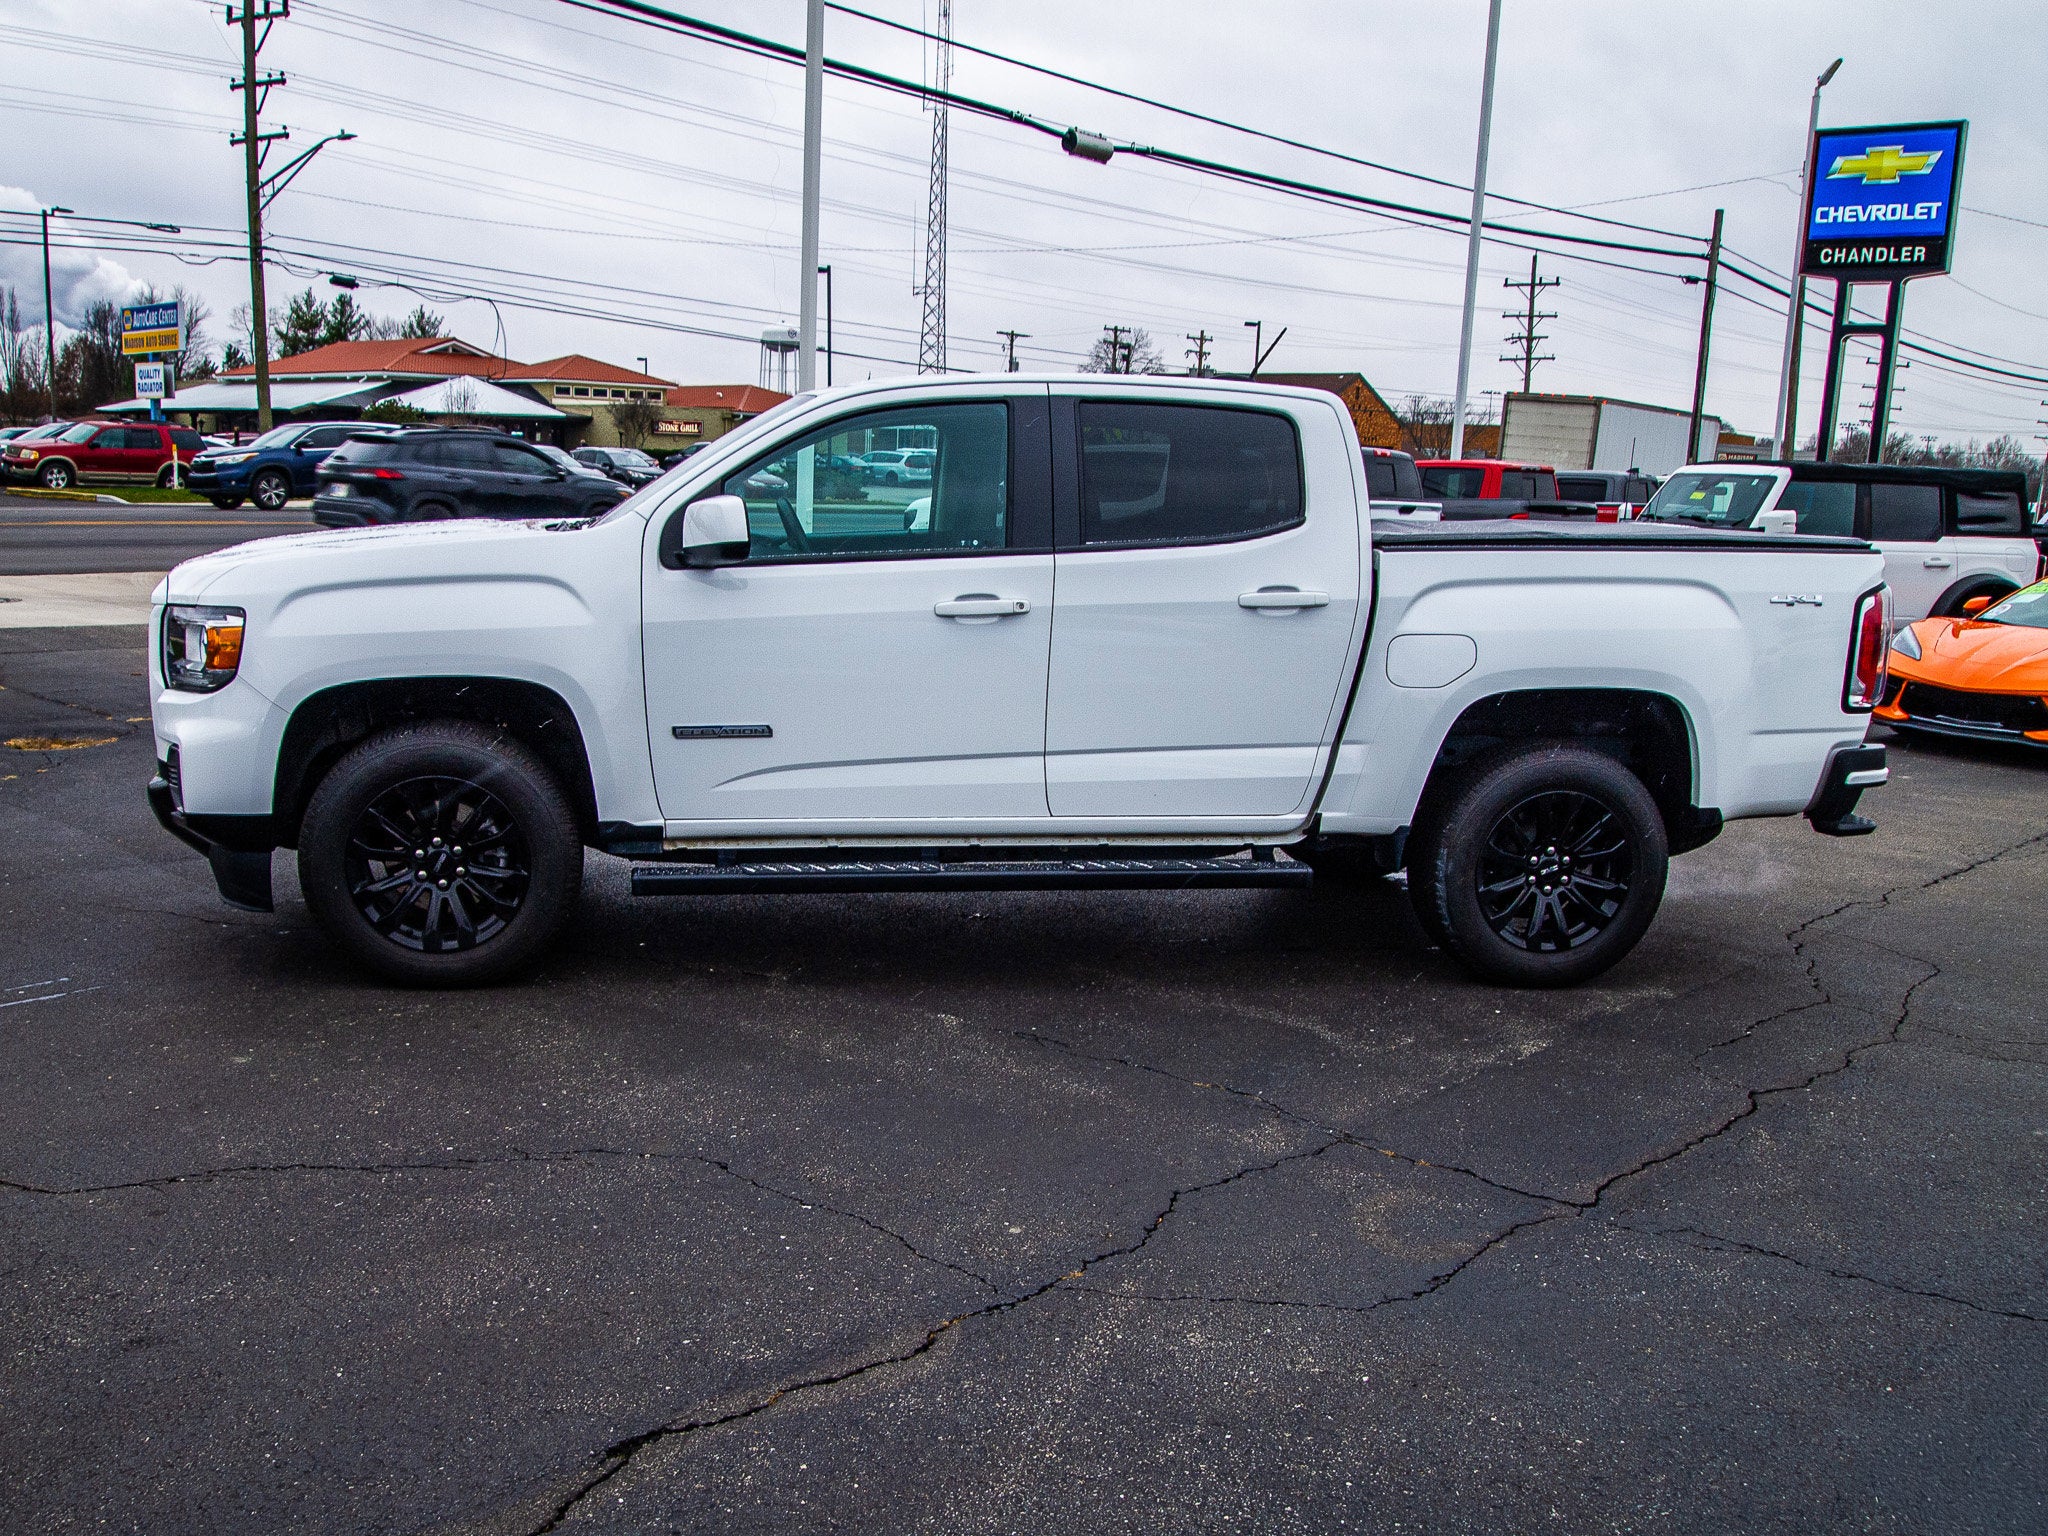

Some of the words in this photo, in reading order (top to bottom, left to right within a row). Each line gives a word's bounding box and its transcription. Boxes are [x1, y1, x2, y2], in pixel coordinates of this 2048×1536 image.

[1815, 201, 1942, 224] CHEVROLET
[1820, 246, 1926, 264] CHANDLER
[159, 308, 177, 325] CENTER
[158, 334, 177, 346] SERVICE
[138, 368, 160, 380] QUALITY
[138, 381, 162, 392] RADIATOR
[658, 422, 679, 432] STONE
[680, 422, 699, 433] GRILL
[677, 727, 767, 737] ELEVATION
